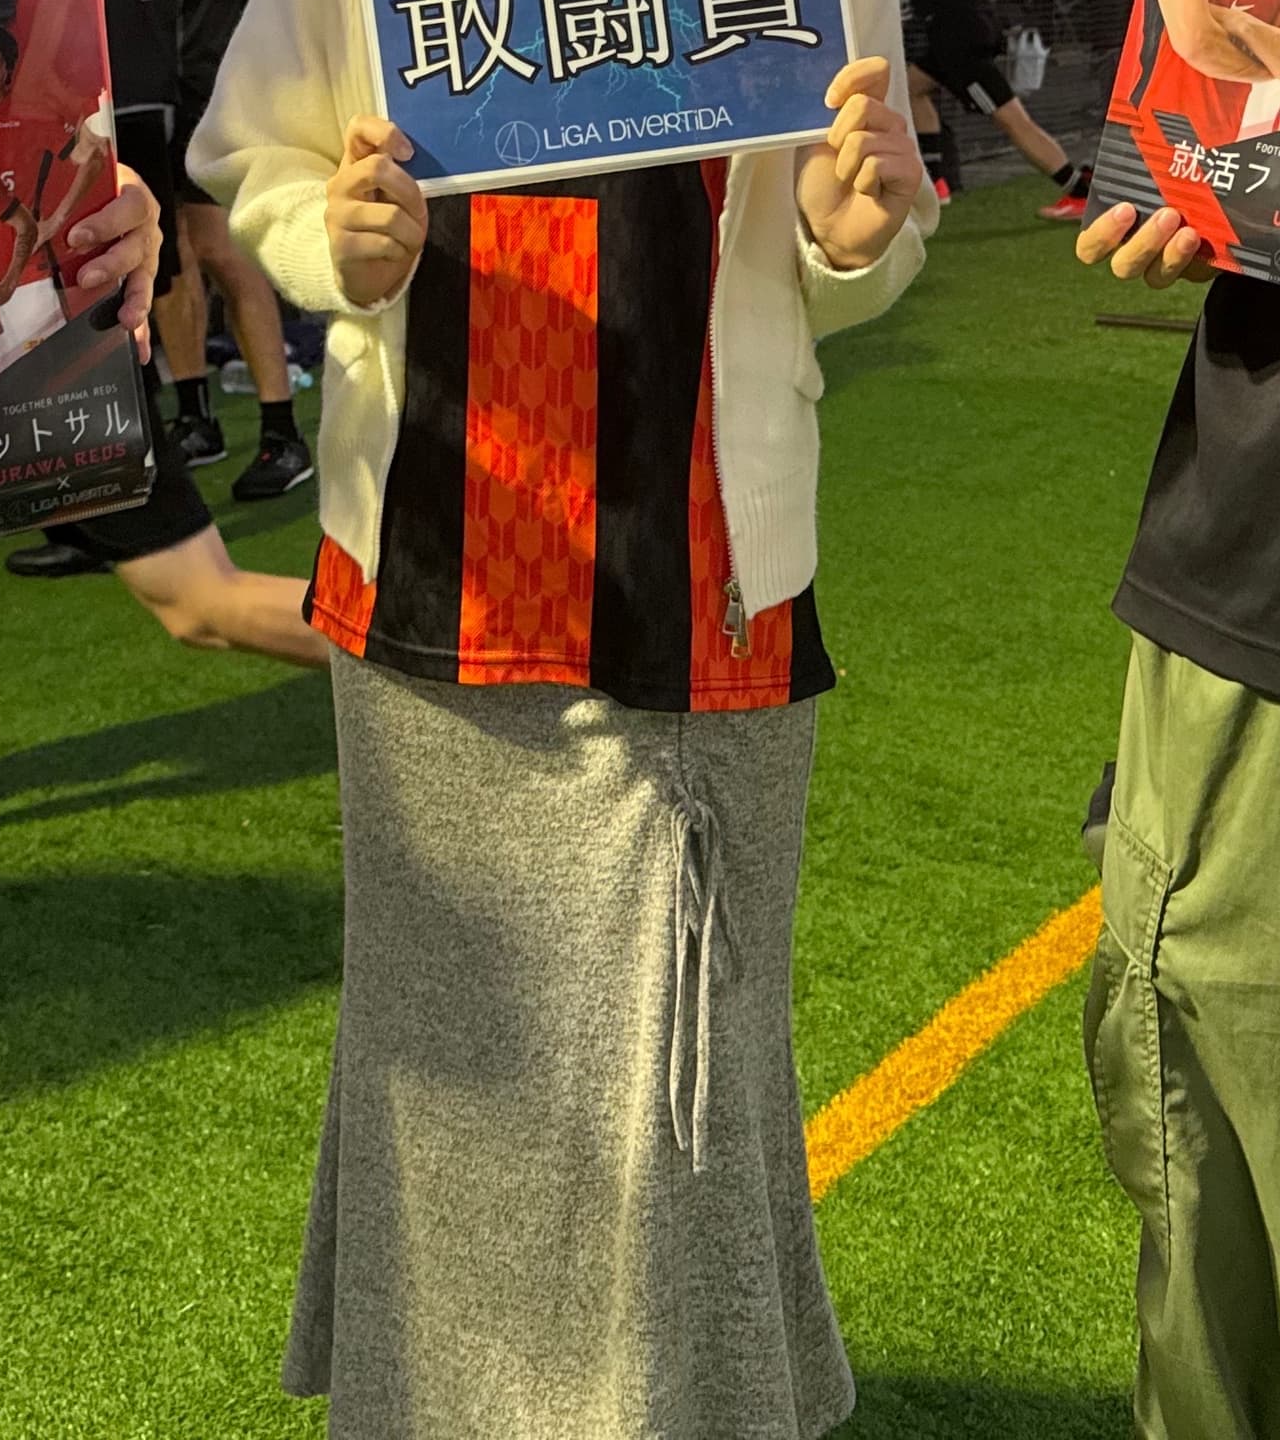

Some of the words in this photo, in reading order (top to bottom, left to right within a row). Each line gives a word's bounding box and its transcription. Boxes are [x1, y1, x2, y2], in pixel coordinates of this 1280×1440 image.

[3, 398, 53, 415] TOGETHER
[58, 389, 89, 405] URAWA
[93, 383, 119, 397] REDS
[75, 442, 127, 467] REDS
